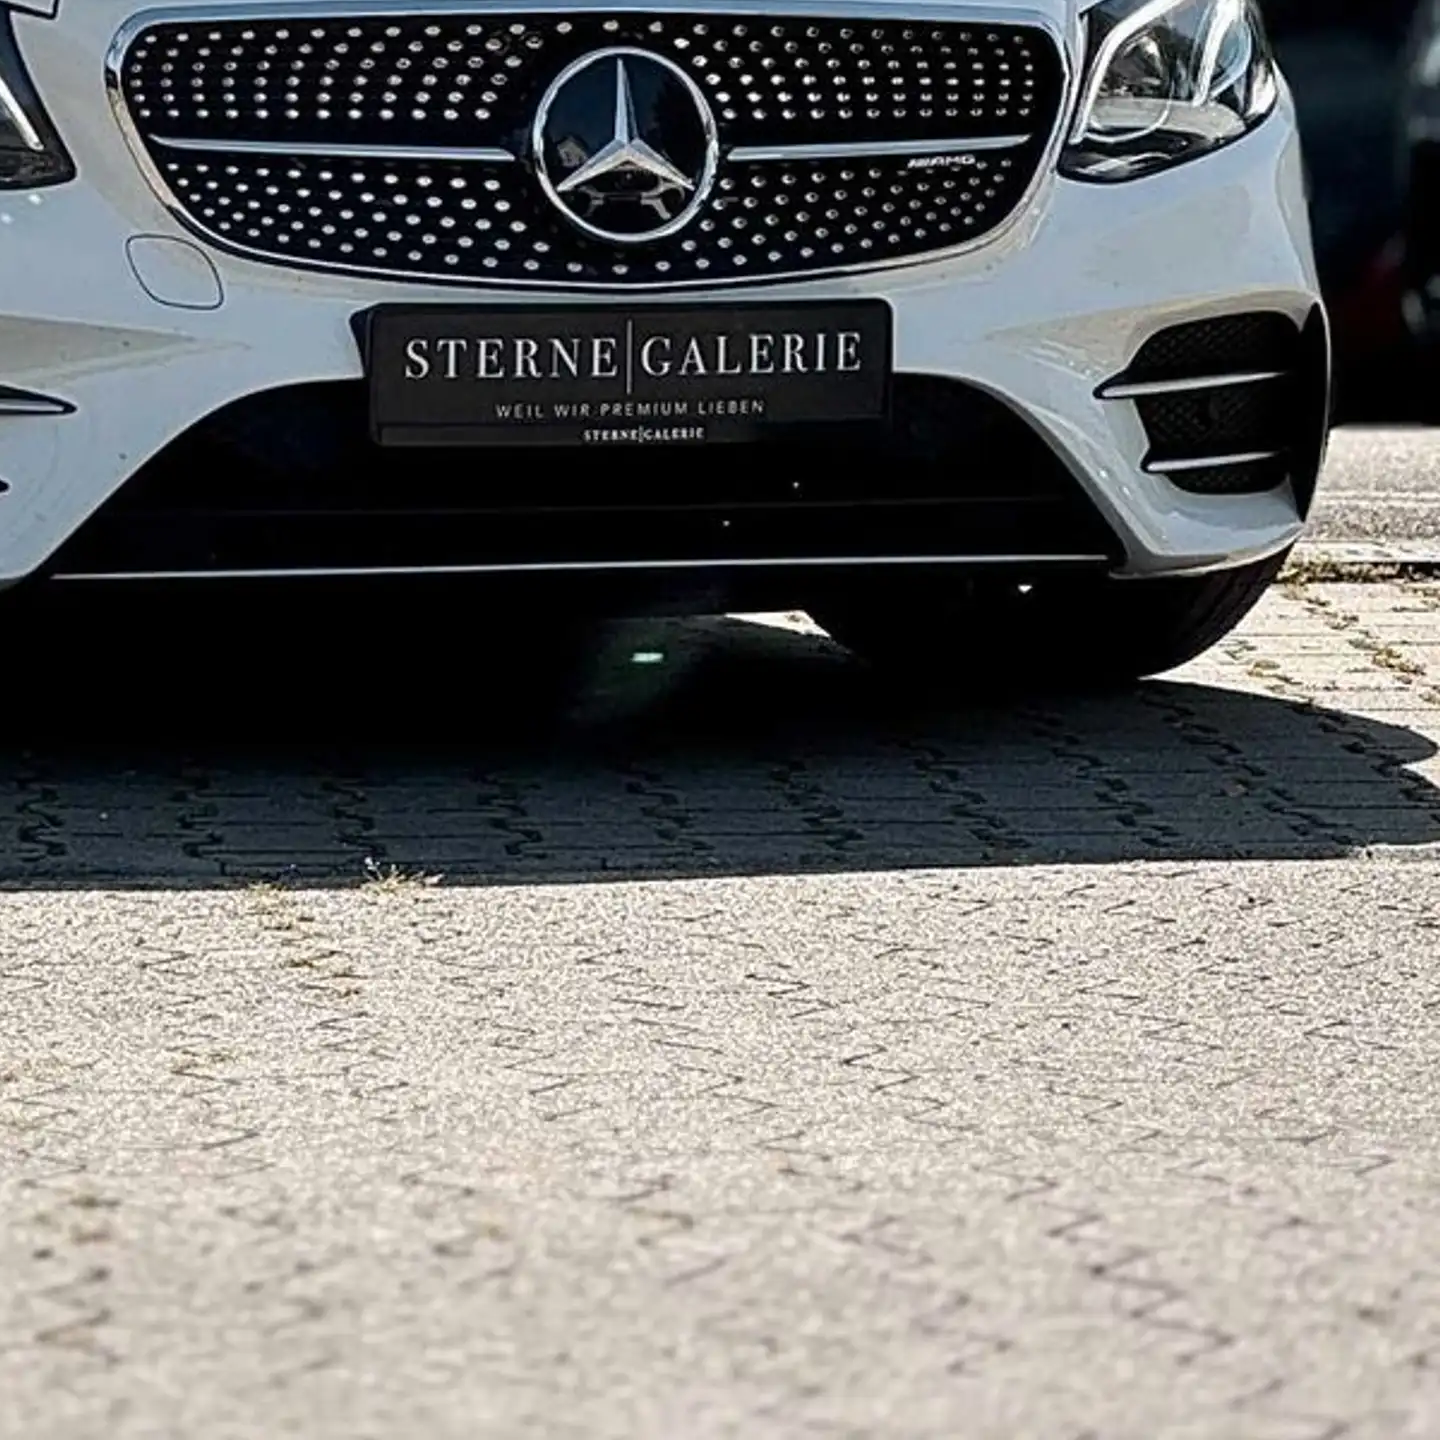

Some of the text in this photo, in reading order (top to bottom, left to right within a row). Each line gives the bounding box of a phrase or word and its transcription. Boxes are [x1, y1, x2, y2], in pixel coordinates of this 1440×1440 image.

[496, 399, 766, 419] WEIL WIR PREMIUM LIEBEN
